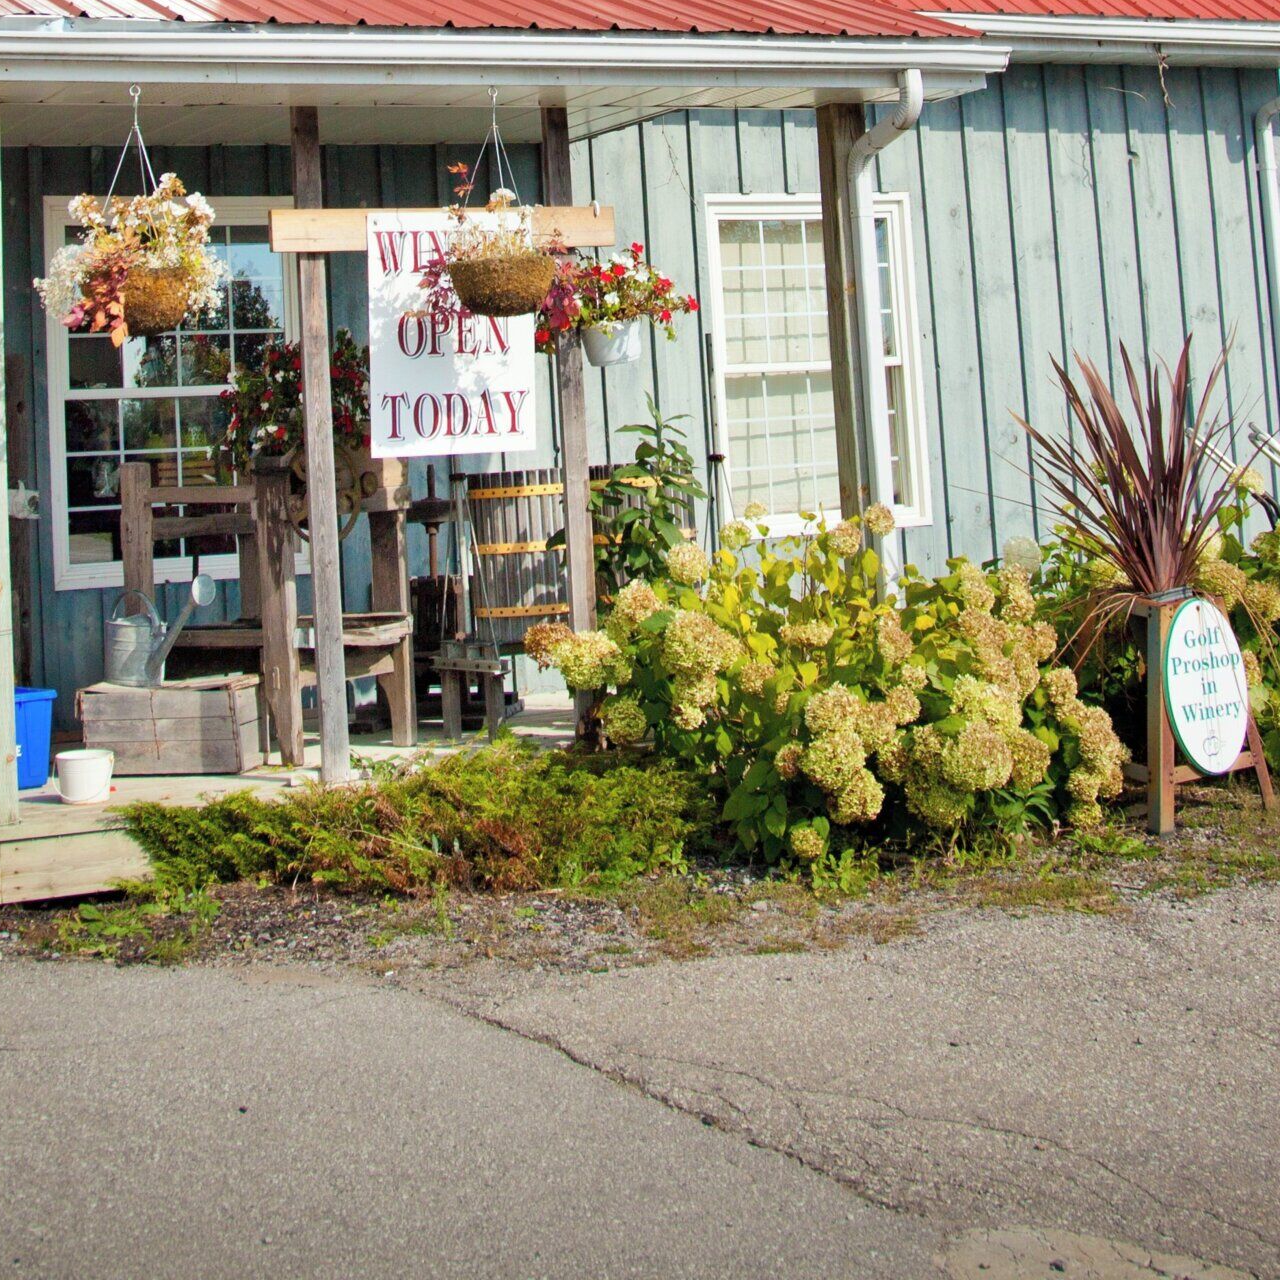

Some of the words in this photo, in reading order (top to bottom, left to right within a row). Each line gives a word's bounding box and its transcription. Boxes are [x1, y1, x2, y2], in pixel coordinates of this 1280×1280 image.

[397, 311, 510, 358] OPEN
[381, 390, 528, 441] TODAY
[1183, 626, 1220, 649] Golf
[1171, 651, 1240, 676] Proshop
[1201, 677, 1217, 696] in
[1181, 700, 1241, 723] Winery
